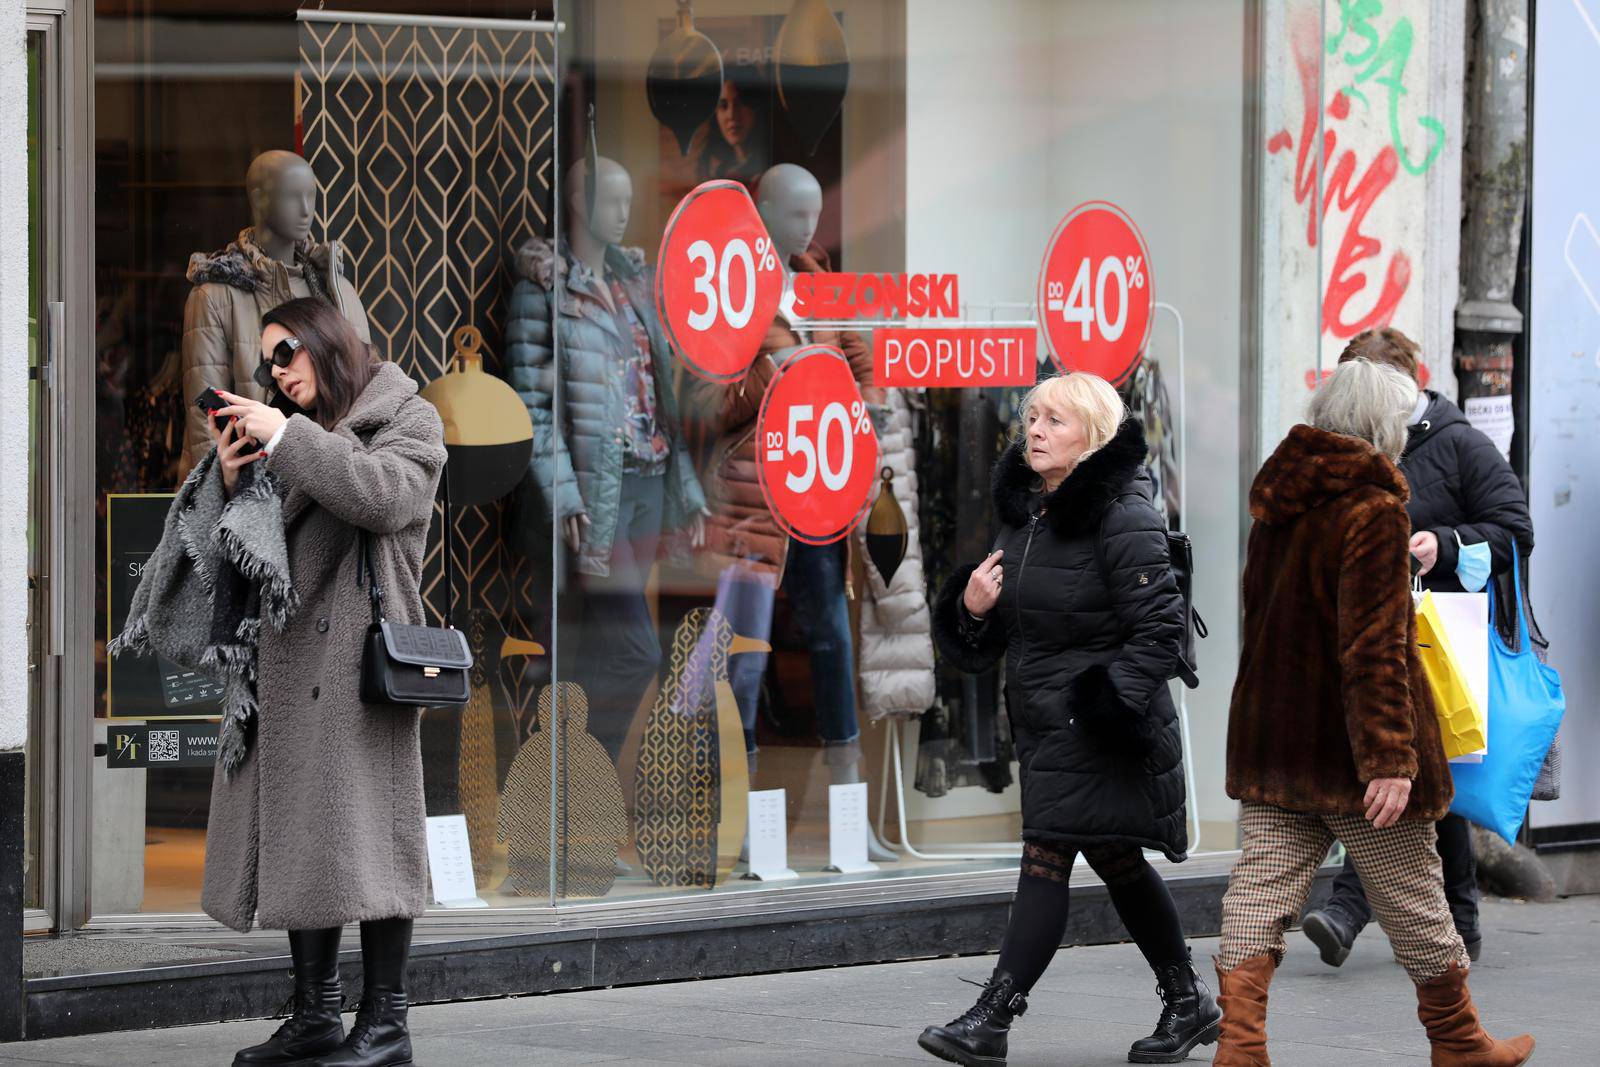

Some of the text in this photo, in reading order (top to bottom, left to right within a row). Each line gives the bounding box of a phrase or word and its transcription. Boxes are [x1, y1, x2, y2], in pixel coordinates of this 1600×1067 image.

[686, 236, 776, 332] 30%
[791, 272, 960, 319] SEZONSKI
[1048, 281, 1064, 298] DO
[885, 338, 1024, 379] POPUSTI
[767, 431, 784, 448] DO
